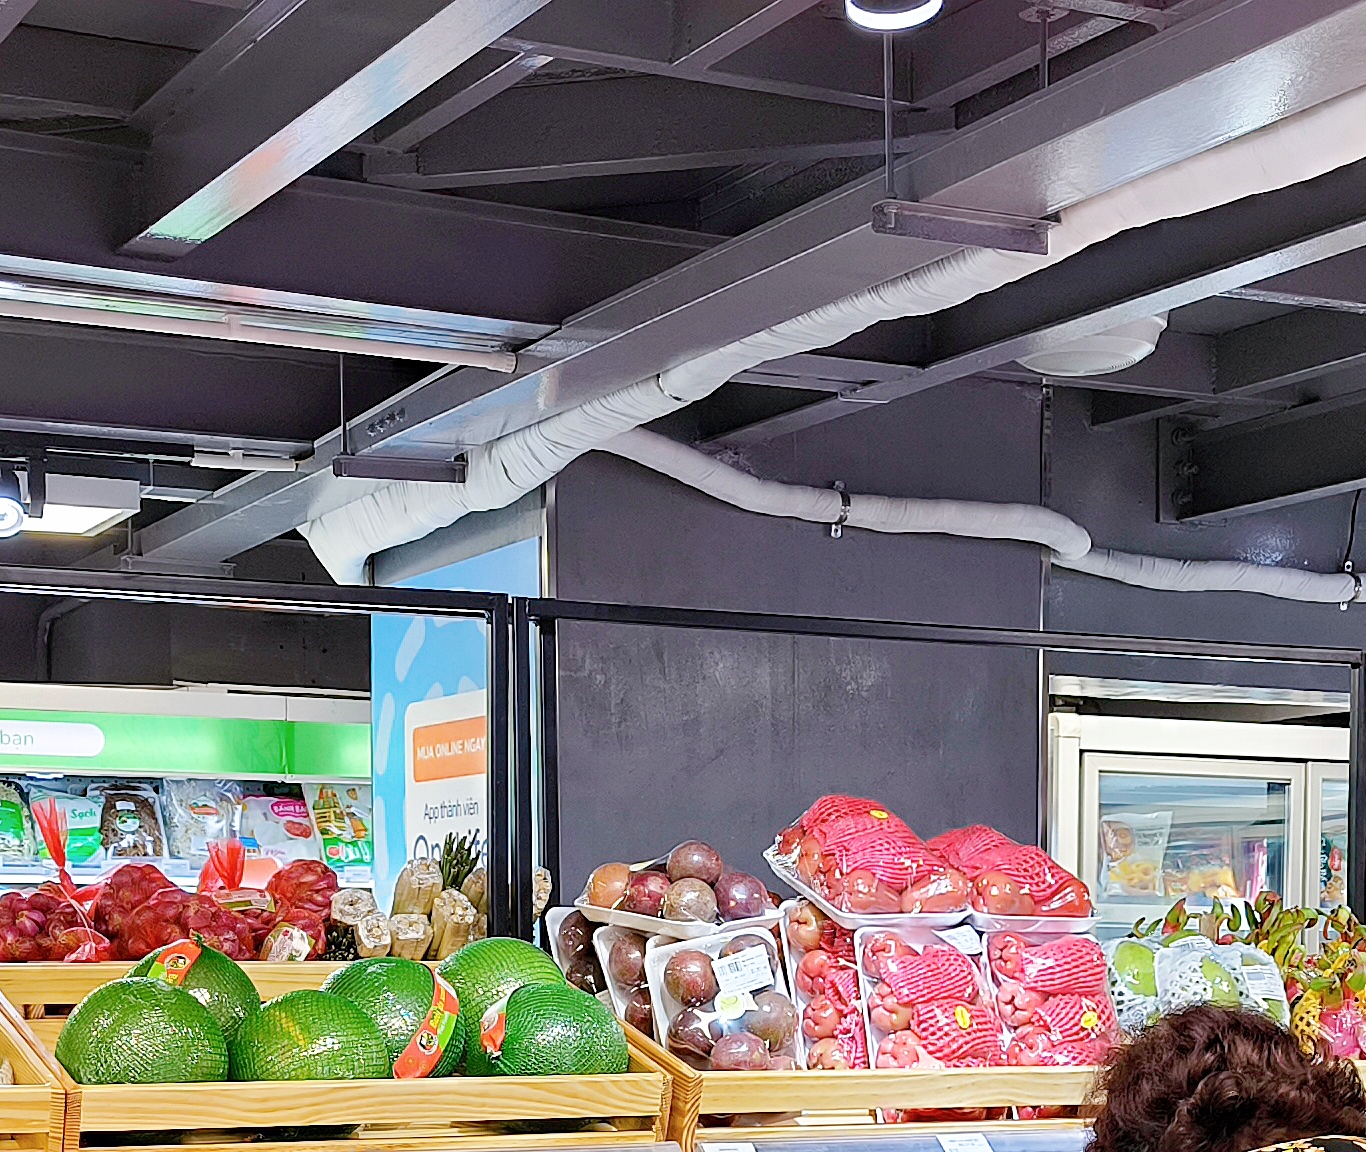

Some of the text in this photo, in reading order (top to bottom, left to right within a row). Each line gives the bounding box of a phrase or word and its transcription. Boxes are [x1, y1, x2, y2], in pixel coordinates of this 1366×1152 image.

[0, 730, 35, 751] bạn
[435, 742, 464, 758] ONLINE
[423, 803, 439, 825] App
